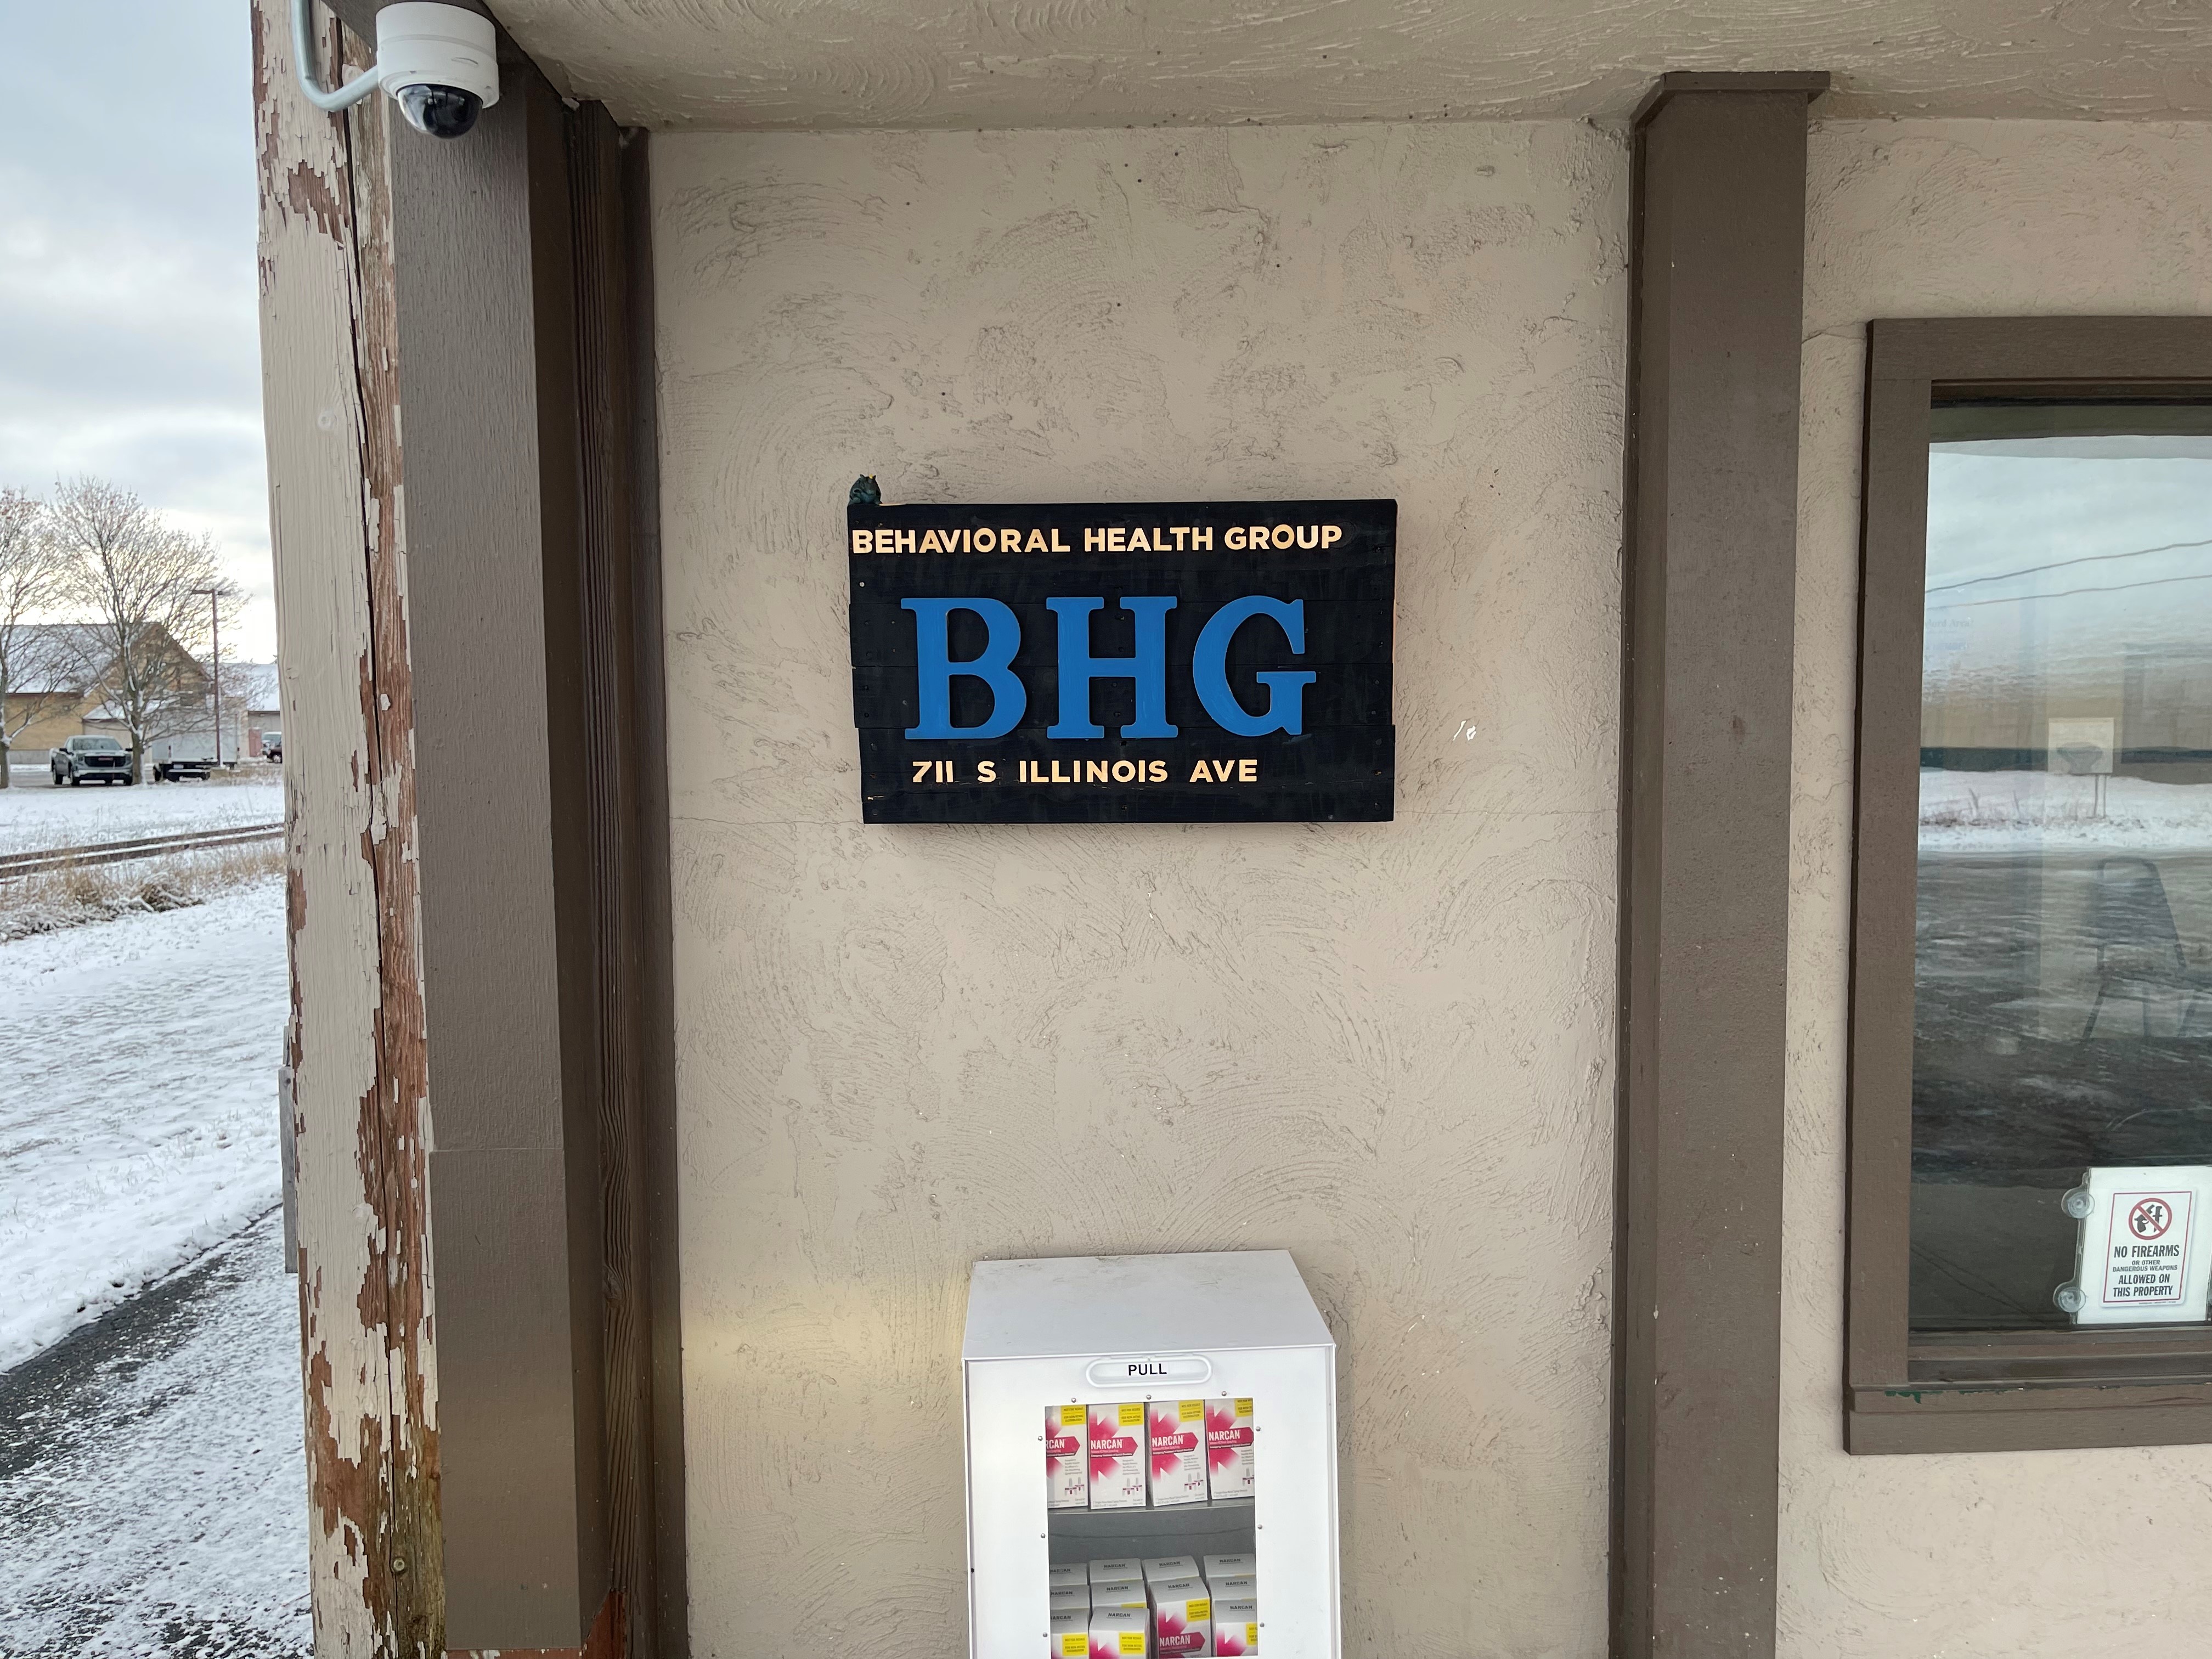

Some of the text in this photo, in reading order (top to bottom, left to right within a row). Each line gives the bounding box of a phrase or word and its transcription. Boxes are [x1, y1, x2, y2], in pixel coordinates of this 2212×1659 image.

[852, 524, 1342, 554] BEHAVIORAL HEALTH GROUP
[900, 595, 1317, 740] BHG
[912, 759, 1257, 783] 711 S ILLINOIS AVE
[2114, 1244, 2180, 1257] NO FIREARMS
[2118, 1273, 2170, 1284] ALLOWED ON
[2113, 1285, 2173, 1297] THIS PROPERTY
[1128, 1363, 1167, 1376] PULL
[1152, 1436, 1183, 1447] NARCAN
[1209, 1430, 1240, 1441] NARCAN
[1090, 1439, 1122, 1449] NARCAN
[1159, 1634, 1190, 1647] NARCAN
